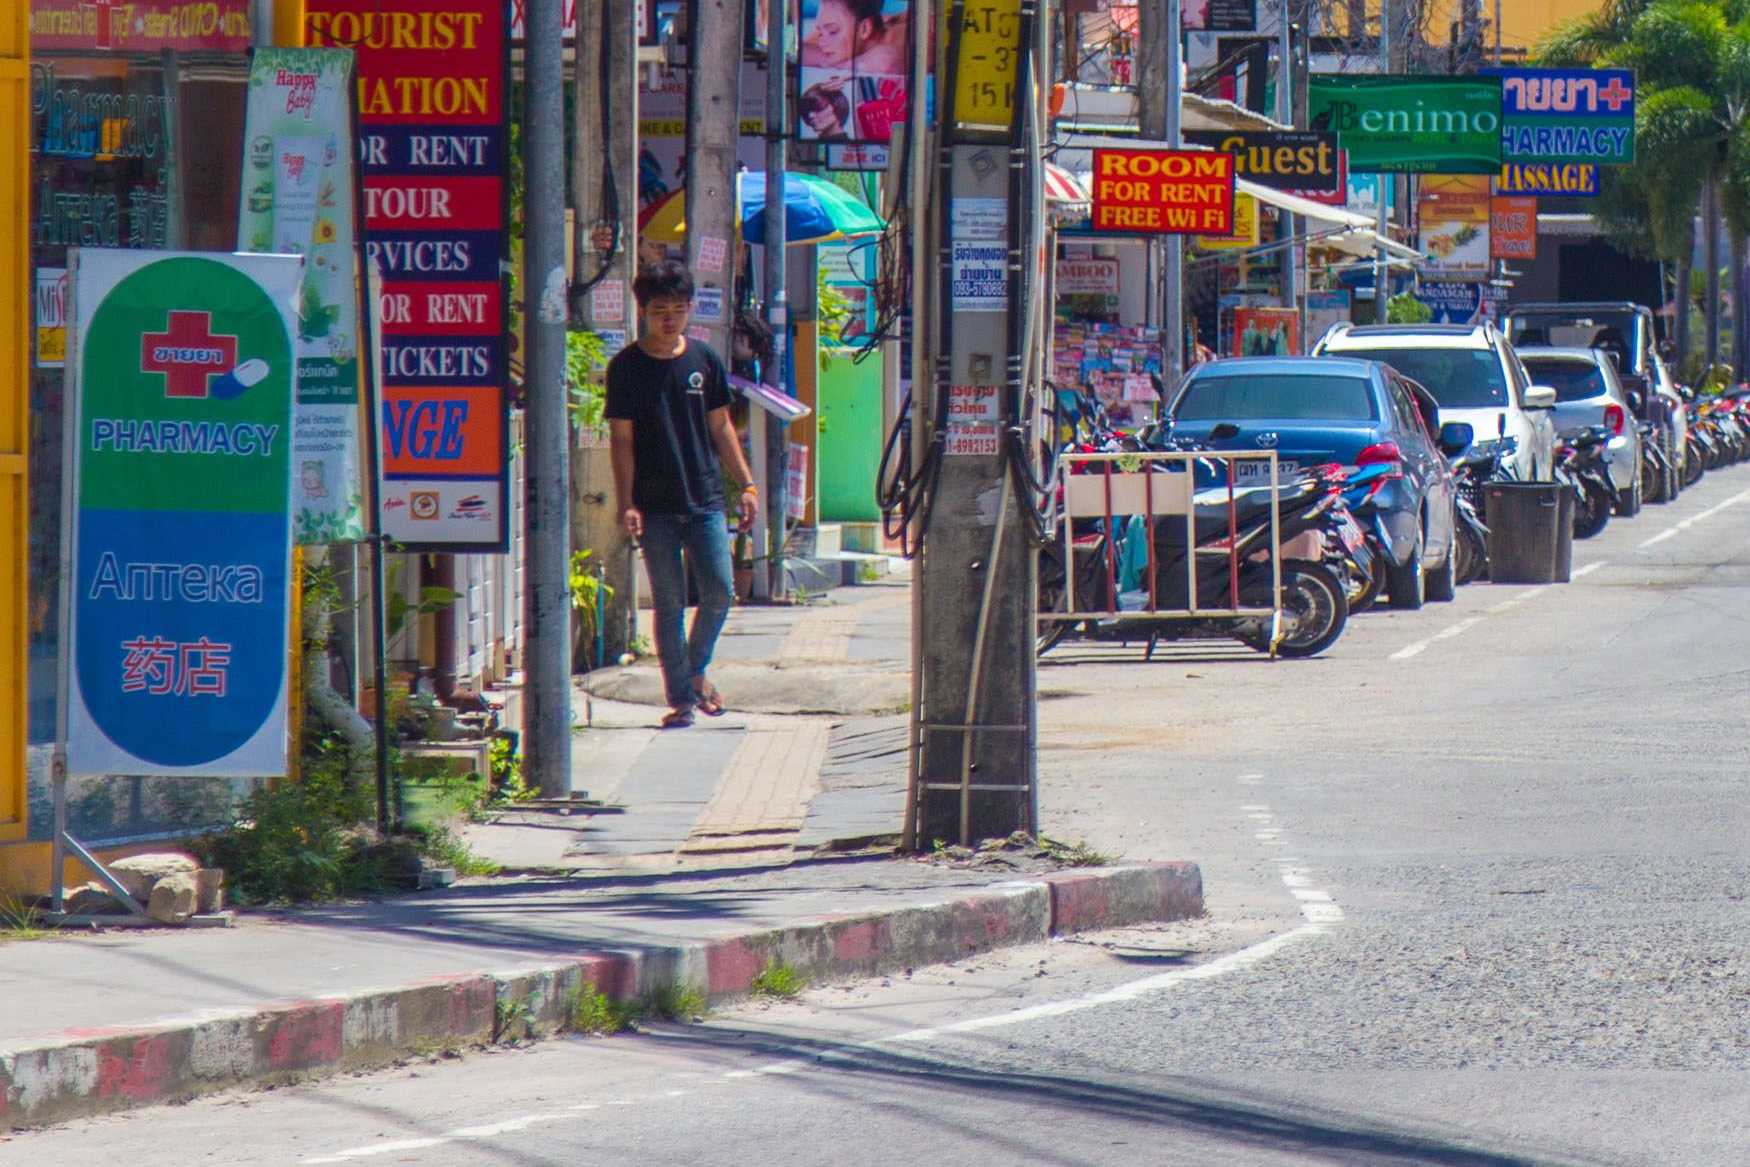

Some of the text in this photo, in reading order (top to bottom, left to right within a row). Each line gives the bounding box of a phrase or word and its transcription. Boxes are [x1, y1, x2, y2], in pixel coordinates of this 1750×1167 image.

[304, 11, 483, 50] TOURIST
[409, 136, 489, 166] RENT
[1100, 155, 1228, 178] ROOM
[363, 187, 453, 219] TOUR
[1100, 180, 1227, 204] FOR RENT
[1100, 205, 1160, 228] FREE
[1166, 208, 1197, 230] Wi
[1203, 208, 1225, 230] Fi
[366, 240, 470, 272] RVICES
[380, 293, 488, 323] OR RENT
[92, 419, 279, 457] PHARMACY
[89, 552, 264, 603] Аптека
[121, 636, 233, 698] 药店
